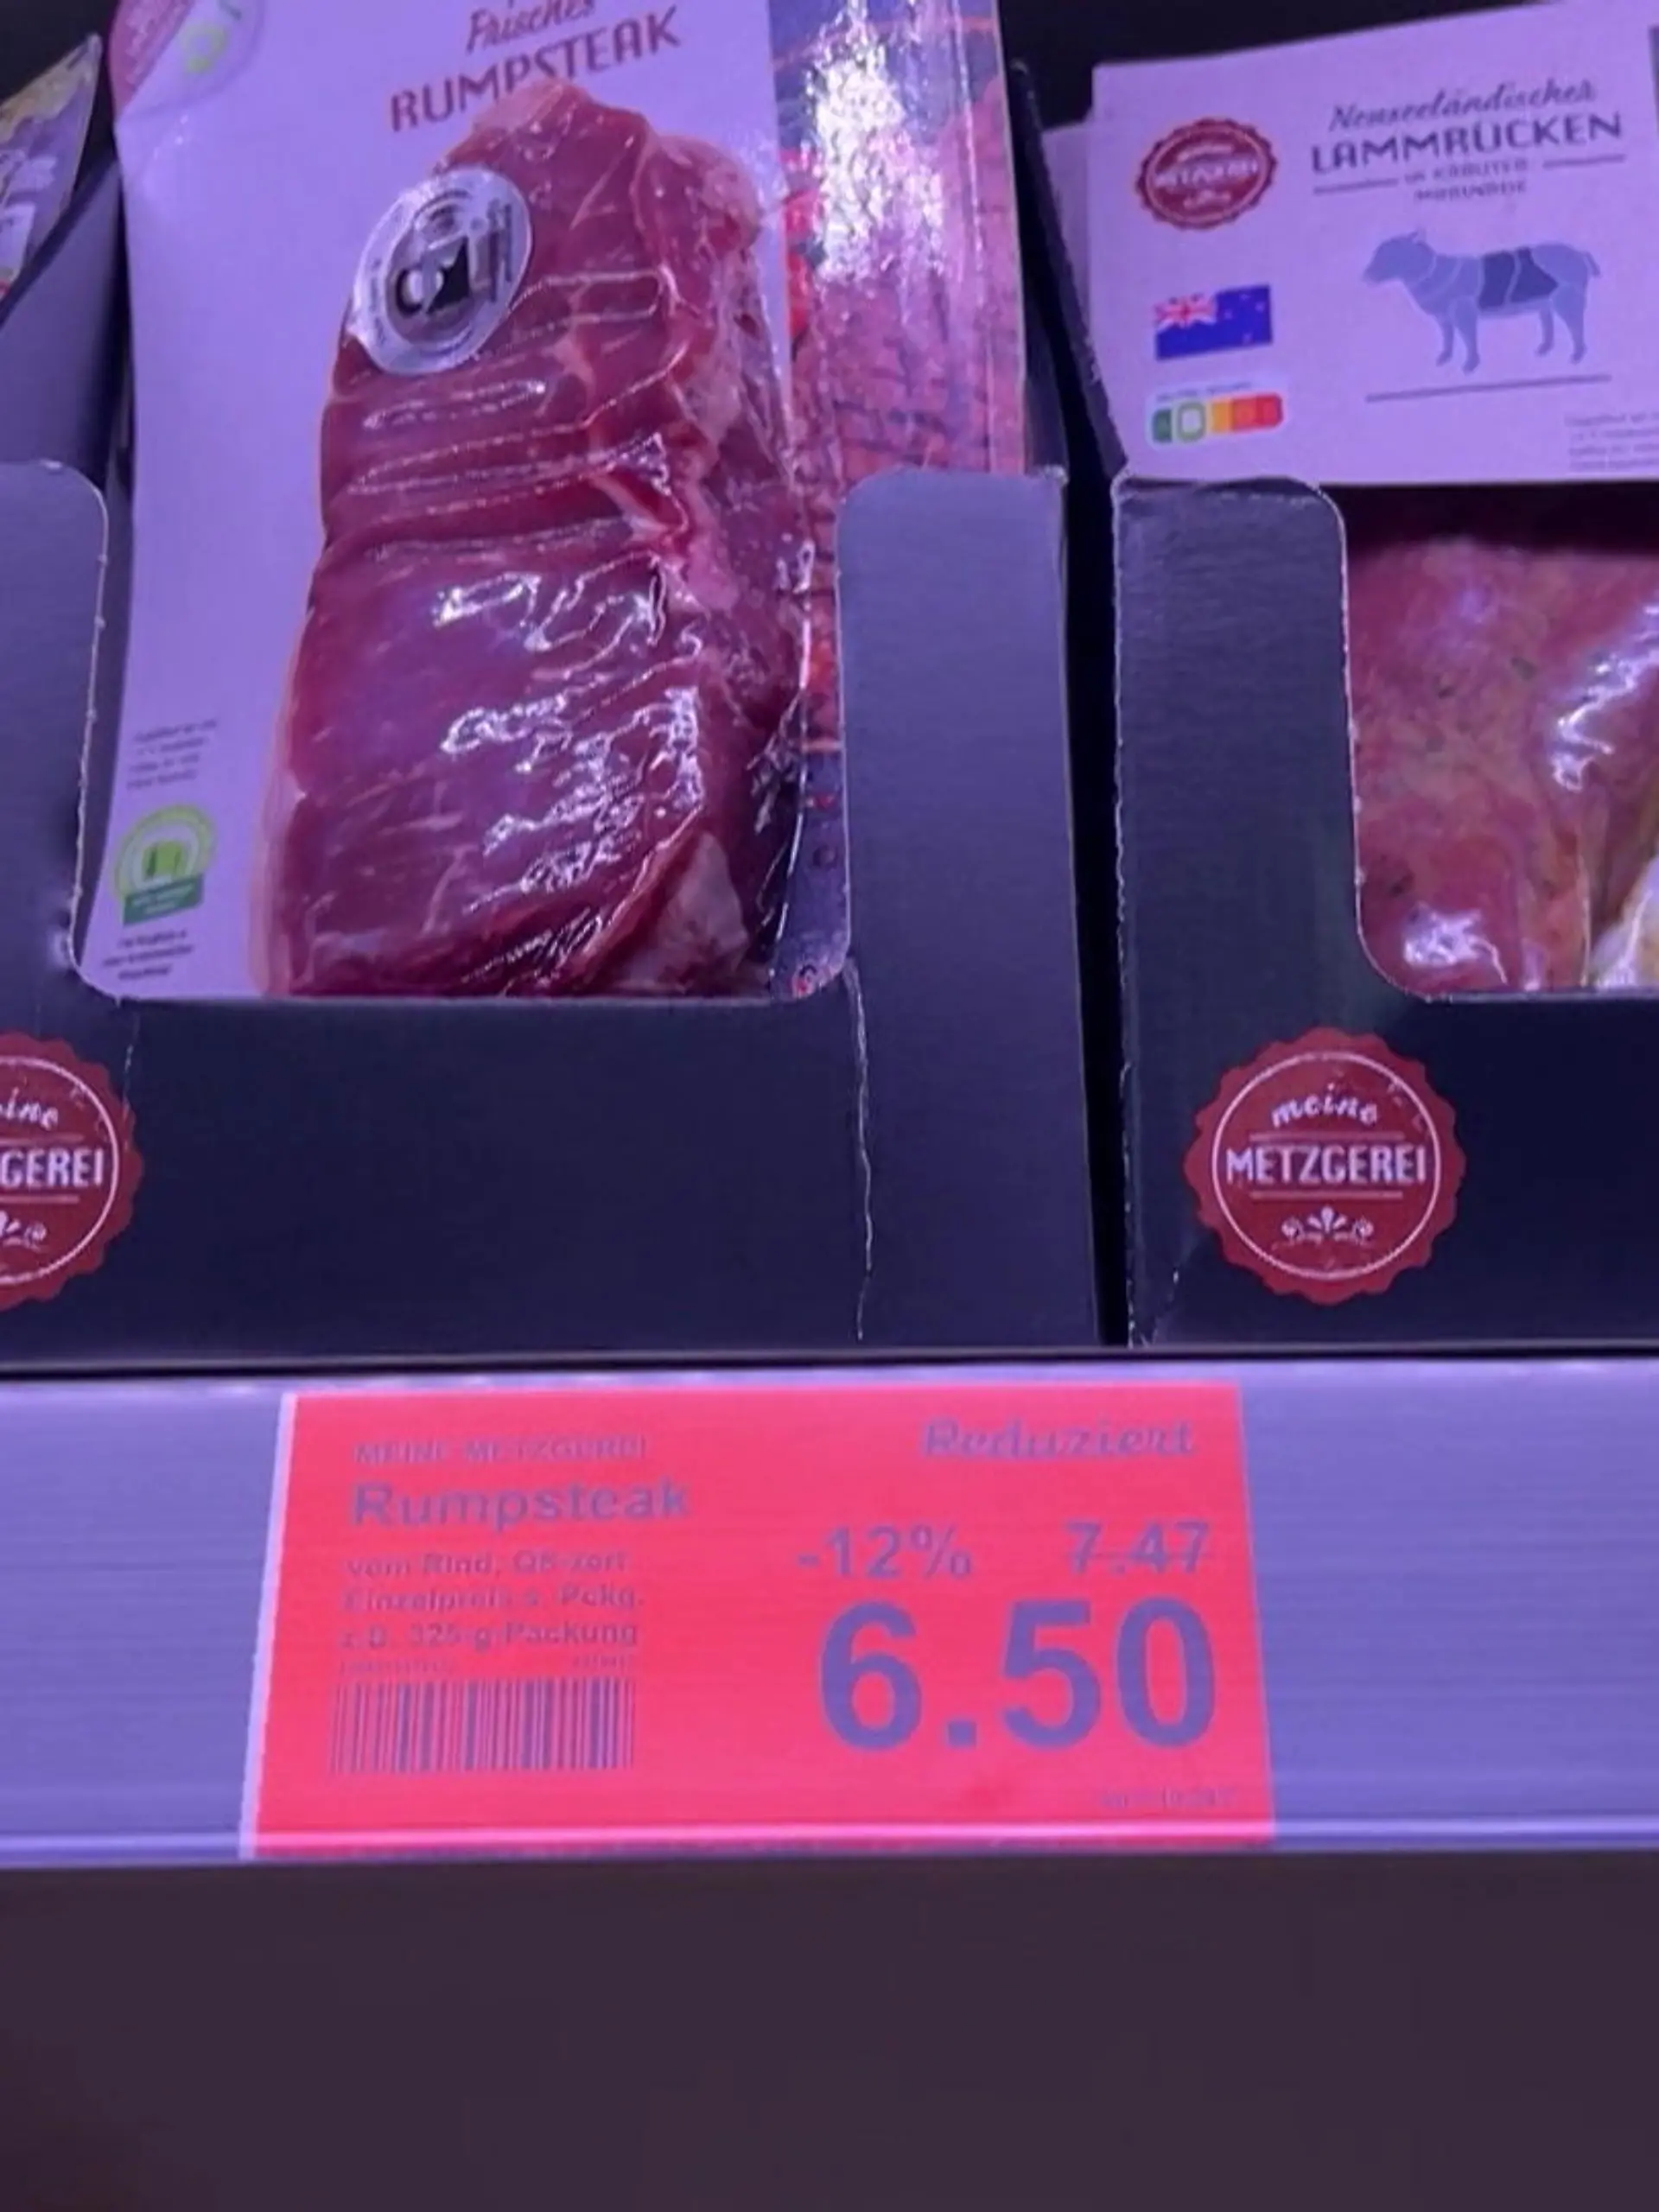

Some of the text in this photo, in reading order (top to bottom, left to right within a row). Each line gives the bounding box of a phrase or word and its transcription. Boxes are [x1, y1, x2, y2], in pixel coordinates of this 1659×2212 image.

[391, 4, 682, 132] RUMPSTEAK
[0, 1086, 59, 1131] ine
[1271, 1082, 1378, 1128] meine
[0, 1147, 105, 1188] GEREI
[1225, 1144, 1427, 1185] METZGEREI
[919, 1415, 1199, 1460] Reduziert
[350, 1477, 691, 1533] Rumpsteak
[795, 1519, 1211, 1580] -12% 7.47
[820, 1597, 1217, 1752] 6.50
